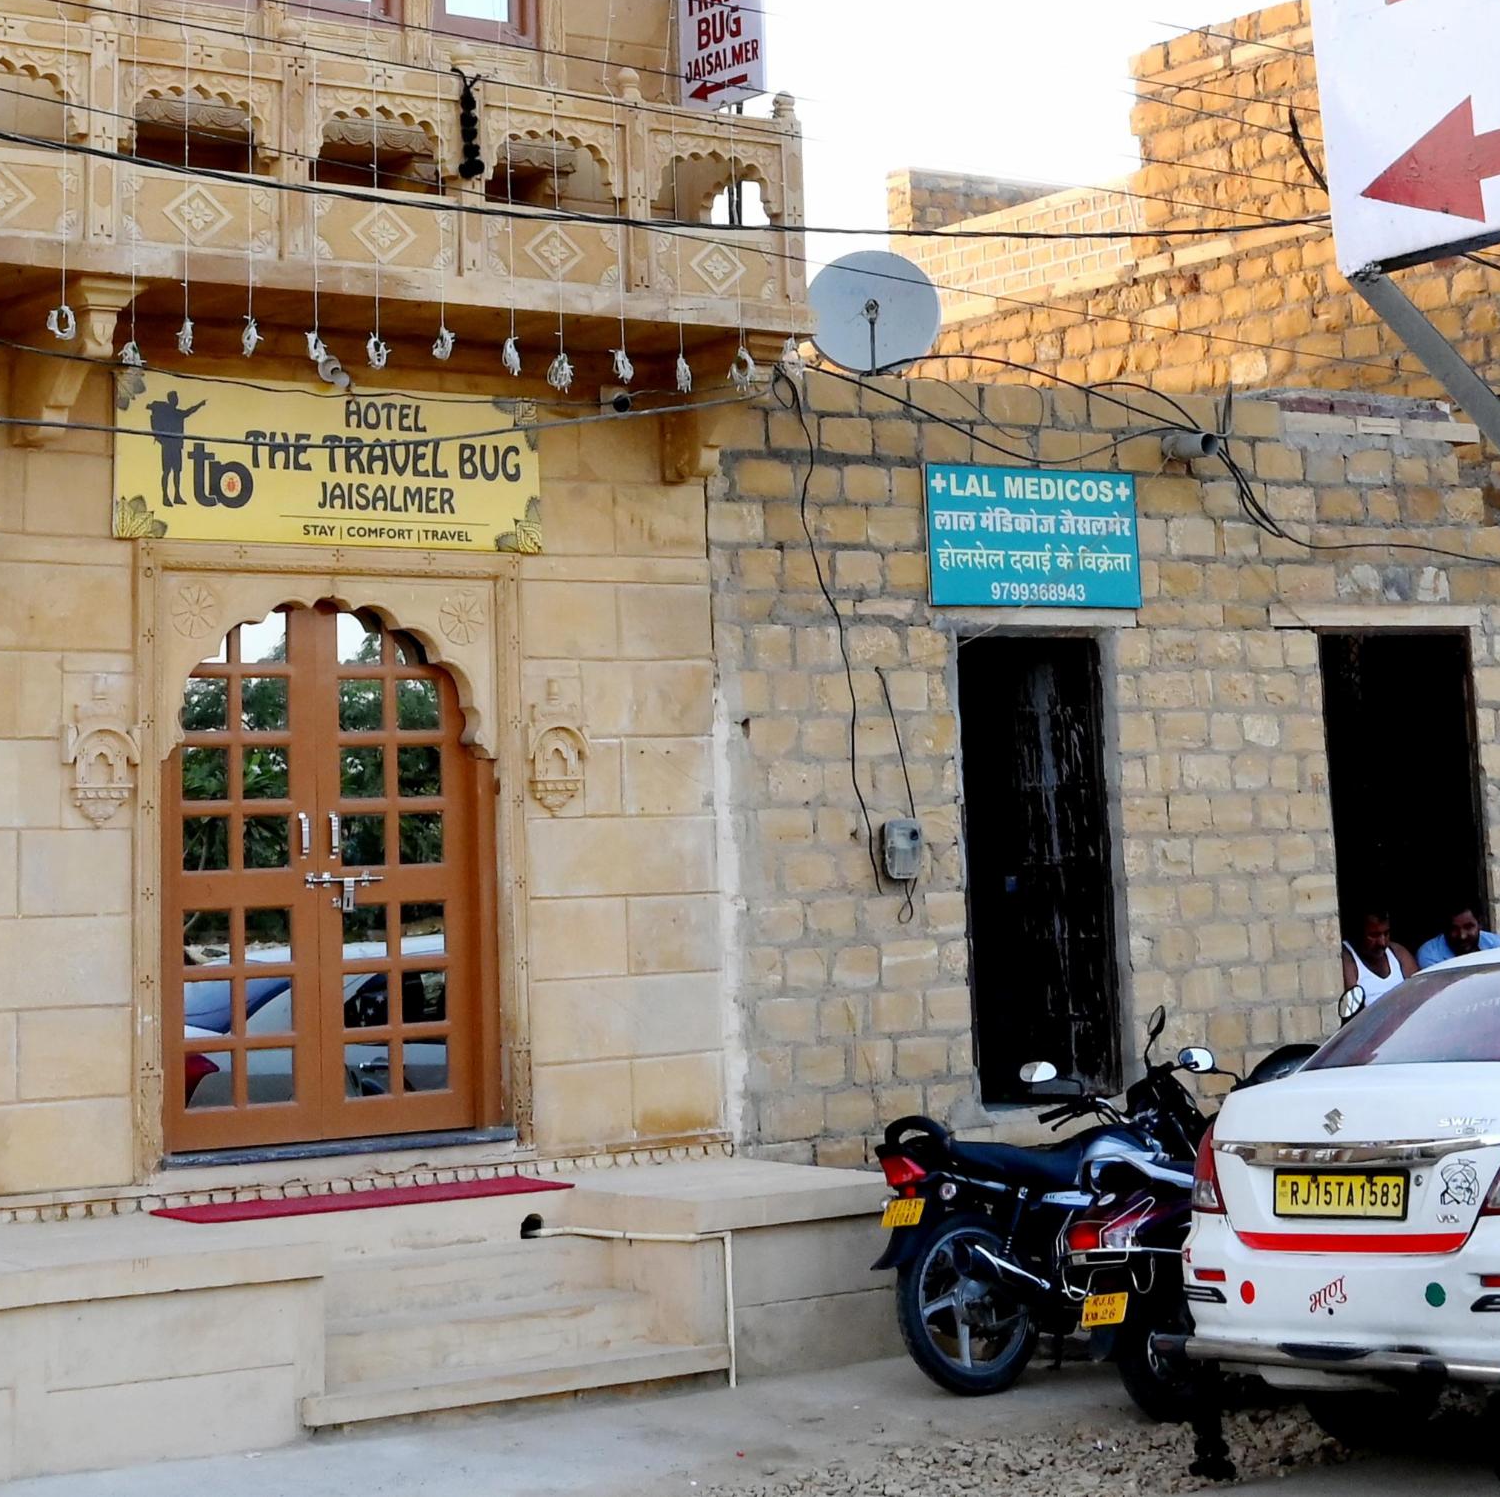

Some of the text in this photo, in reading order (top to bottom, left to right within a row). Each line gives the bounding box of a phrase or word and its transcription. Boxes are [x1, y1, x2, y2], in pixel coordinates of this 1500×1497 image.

[697, 5, 742, 51] BUG
[685, 38, 760, 84] JAISALMER
[344, 400, 427, 433] HOTEL
[244, 430, 521, 483] THE TRAVEL BUG
[317, 480, 456, 515] JAISALMER
[949, 473, 1114, 503] LAL MEDICOS
[302, 524, 473, 542] STAY COMFORT TRAVEL
[933, 506, 1132, 536] लाल मेडिकोज जैसलमेर
[937, 540, 1132, 575] होलसेल दवाई के विक्रेता
[990, 582, 1086, 602] 9799368943
[1436, 1116, 1498, 1128] SWIFT
[1290, 1180, 1401, 1207] RJ15TA1583
